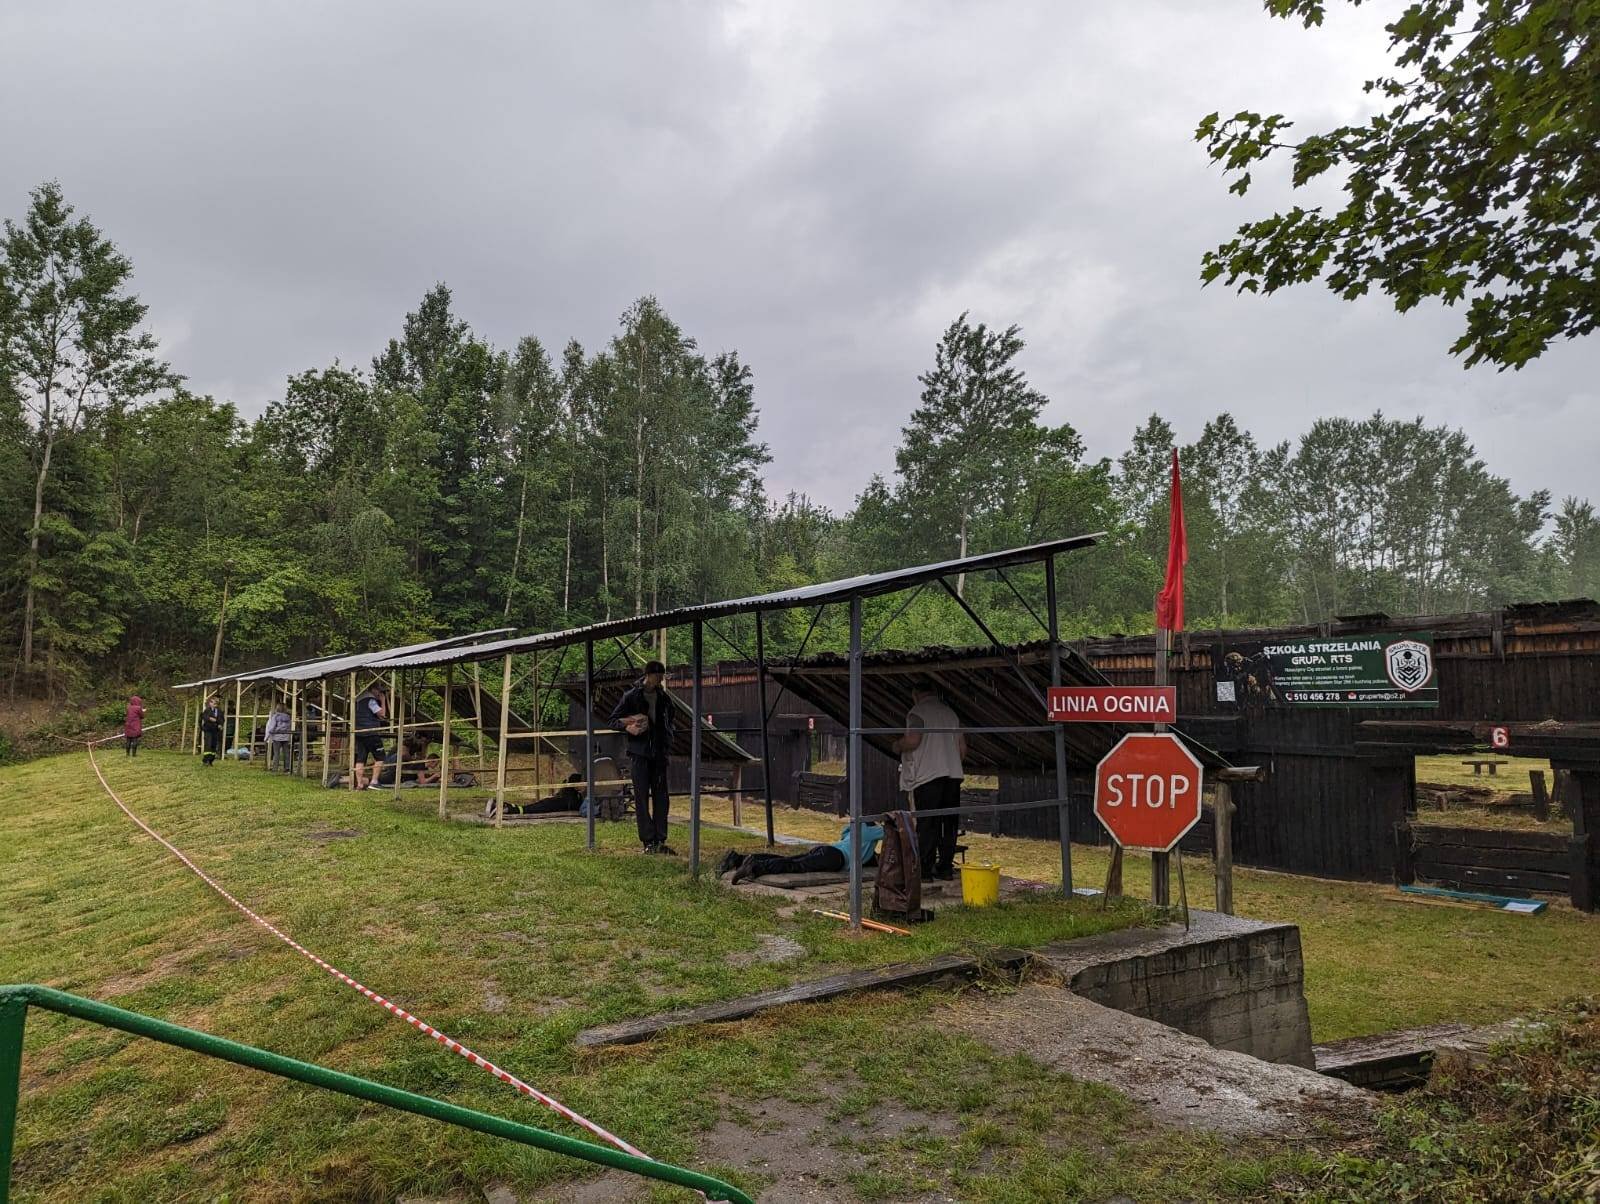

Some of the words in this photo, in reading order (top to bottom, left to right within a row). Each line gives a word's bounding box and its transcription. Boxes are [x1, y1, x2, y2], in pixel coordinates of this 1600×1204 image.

[1263, 644, 1306, 655] SZKOŁA
[1308, 640, 1381, 653] STRZELANIA
[1291, 655, 1326, 665] GRUPA
[1330, 654, 1353, 664] RTS
[1053, 696, 1099, 712] LINIA
[1103, 696, 1170, 713] OGNIA
[1294, 693, 1308, 701] 510
[1309, 692, 1324, 701] 456
[1325, 692, 1341, 701] 278
[1493, 727, 1508, 747] 6
[1106, 774, 1190, 809] STOP
